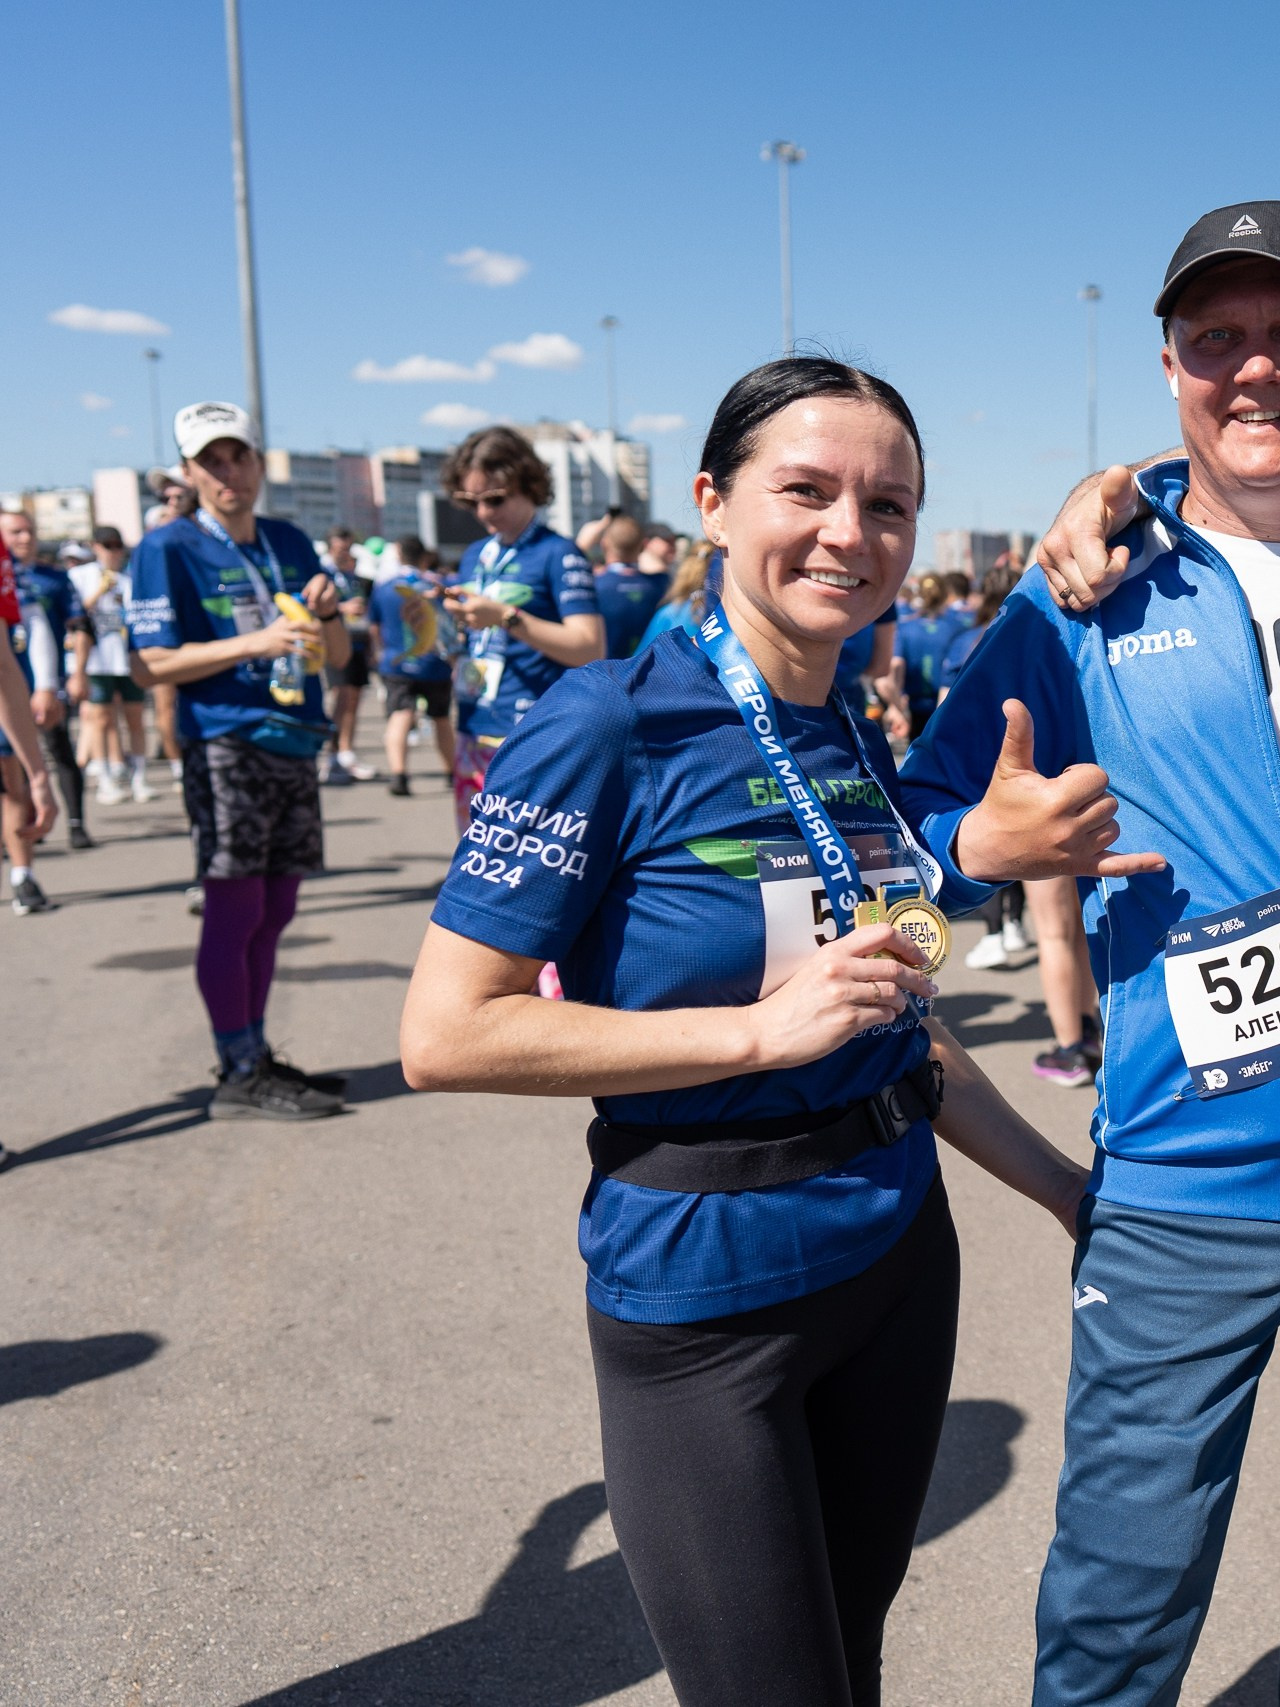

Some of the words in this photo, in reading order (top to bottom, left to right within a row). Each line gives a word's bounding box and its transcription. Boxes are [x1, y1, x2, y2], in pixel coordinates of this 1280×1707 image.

[1229, 229, 1262, 238] Reebok
[725, 664, 783, 755] ГЕРОИ
[774, 759, 853, 882] МЕНЯЮТ
[771, 856, 785, 868] 10
[788, 854, 809, 867] КМ
[460, 850, 524, 888] 2024
[1178, 932, 1192, 944] КМ
